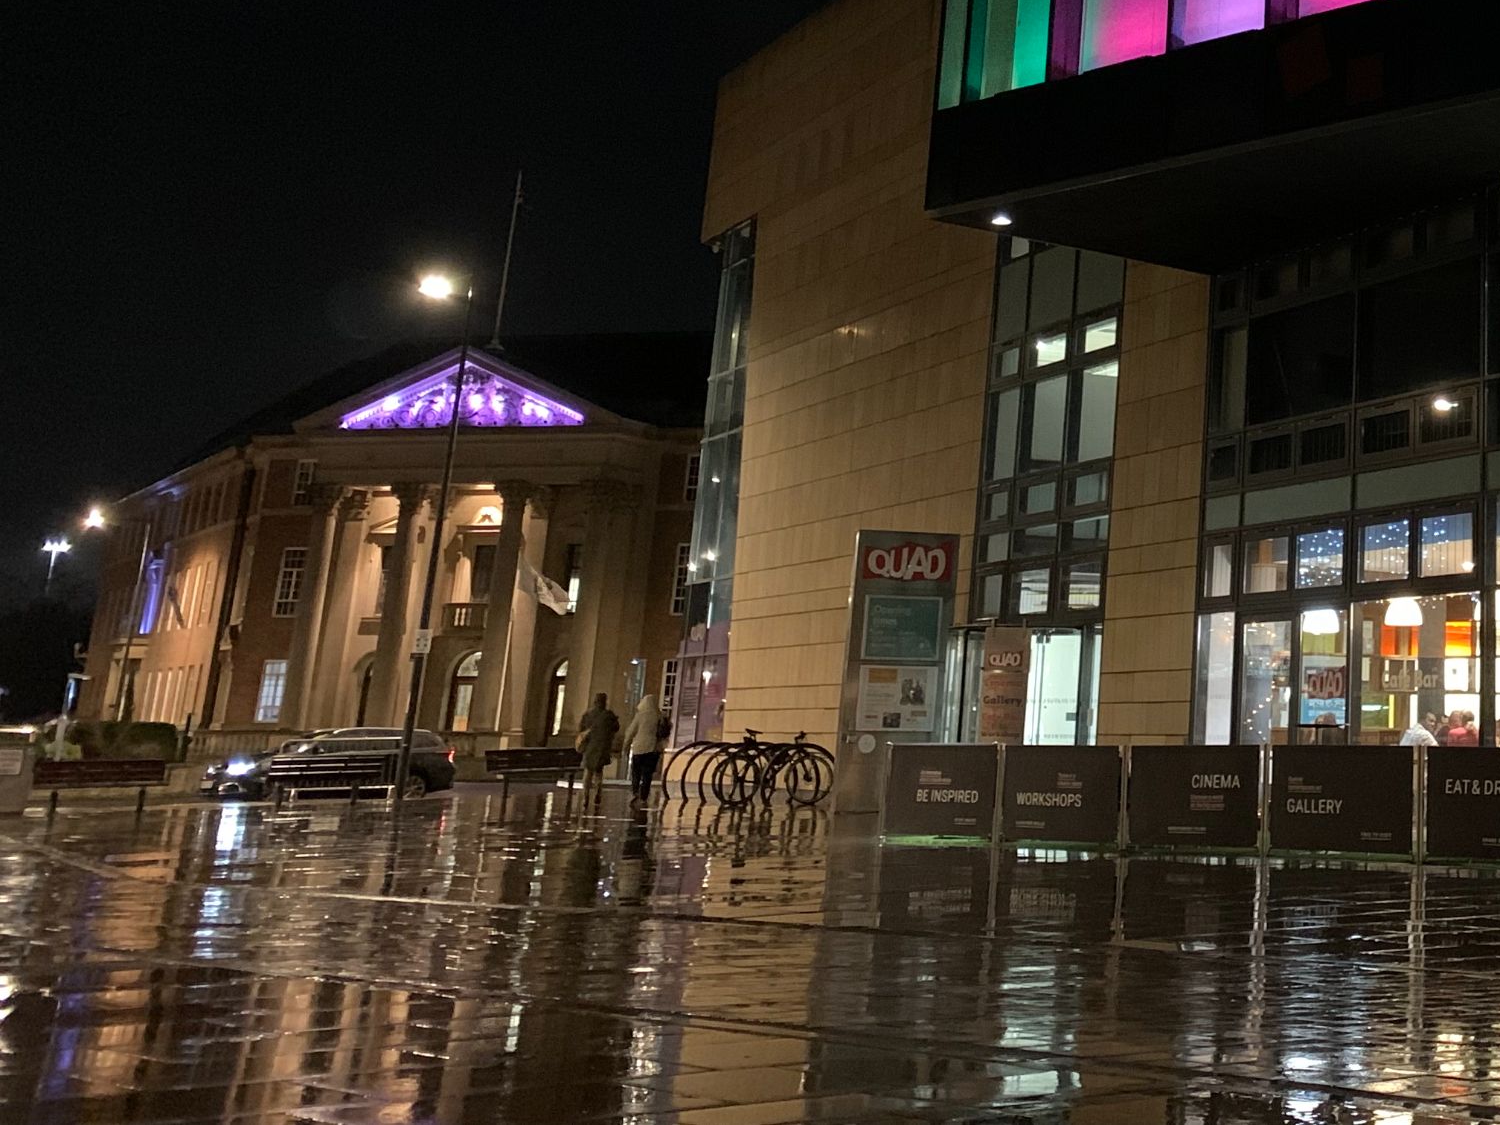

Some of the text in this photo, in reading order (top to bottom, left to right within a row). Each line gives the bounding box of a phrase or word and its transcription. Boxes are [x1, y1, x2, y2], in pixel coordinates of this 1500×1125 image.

[867, 546, 946, 581] QUAD
[989, 652, 1021, 667] QUAD
[1414, 669, 1438, 689] Bar
[1191, 774, 1241, 789] CINEMA
[916, 789, 979, 804] BE INSPIRED
[1016, 792, 1082, 808] WORKSHOPS
[1286, 798, 1343, 814] GALLERY
